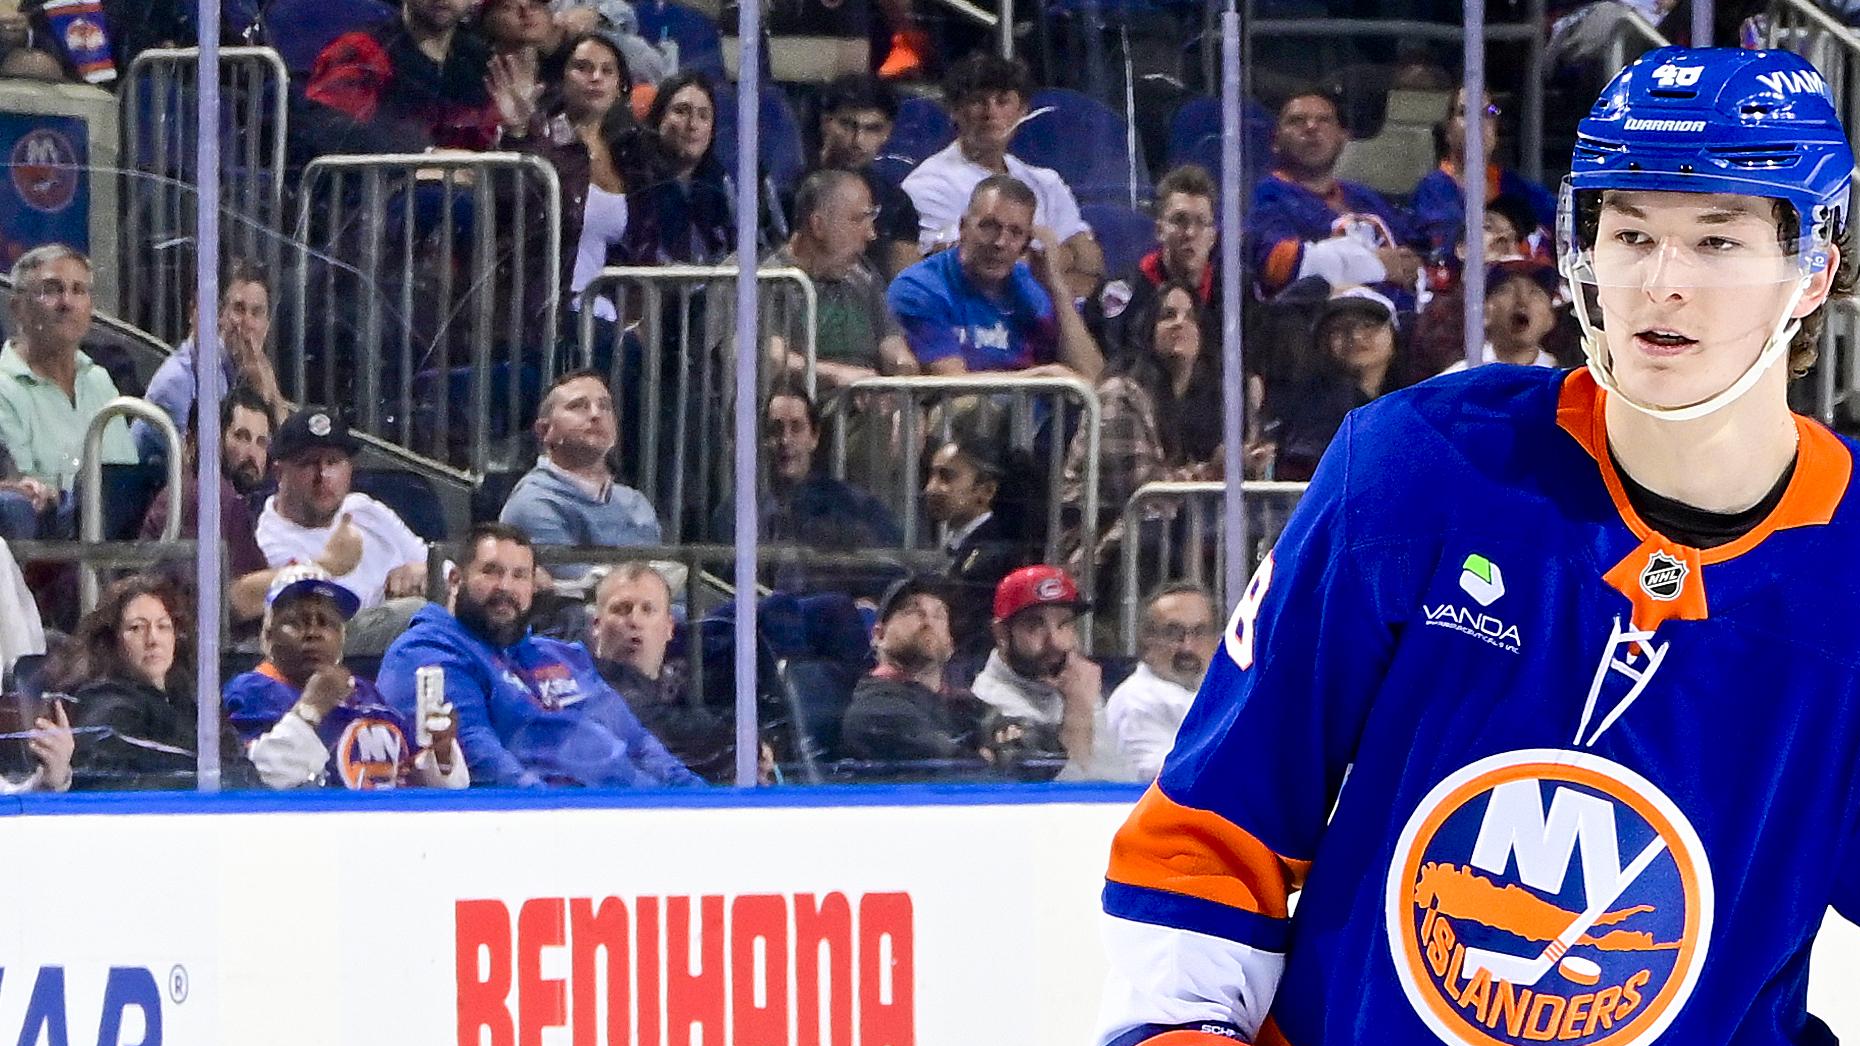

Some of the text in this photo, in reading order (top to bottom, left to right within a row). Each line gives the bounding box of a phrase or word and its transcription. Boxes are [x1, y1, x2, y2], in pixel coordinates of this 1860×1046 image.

[1624, 118, 1707, 132] WARRIOR
[1647, 569, 1679, 584] NHL
[1422, 604, 1521, 646] VANDA
[1420, 909, 1652, 1042] ISLANDERS
